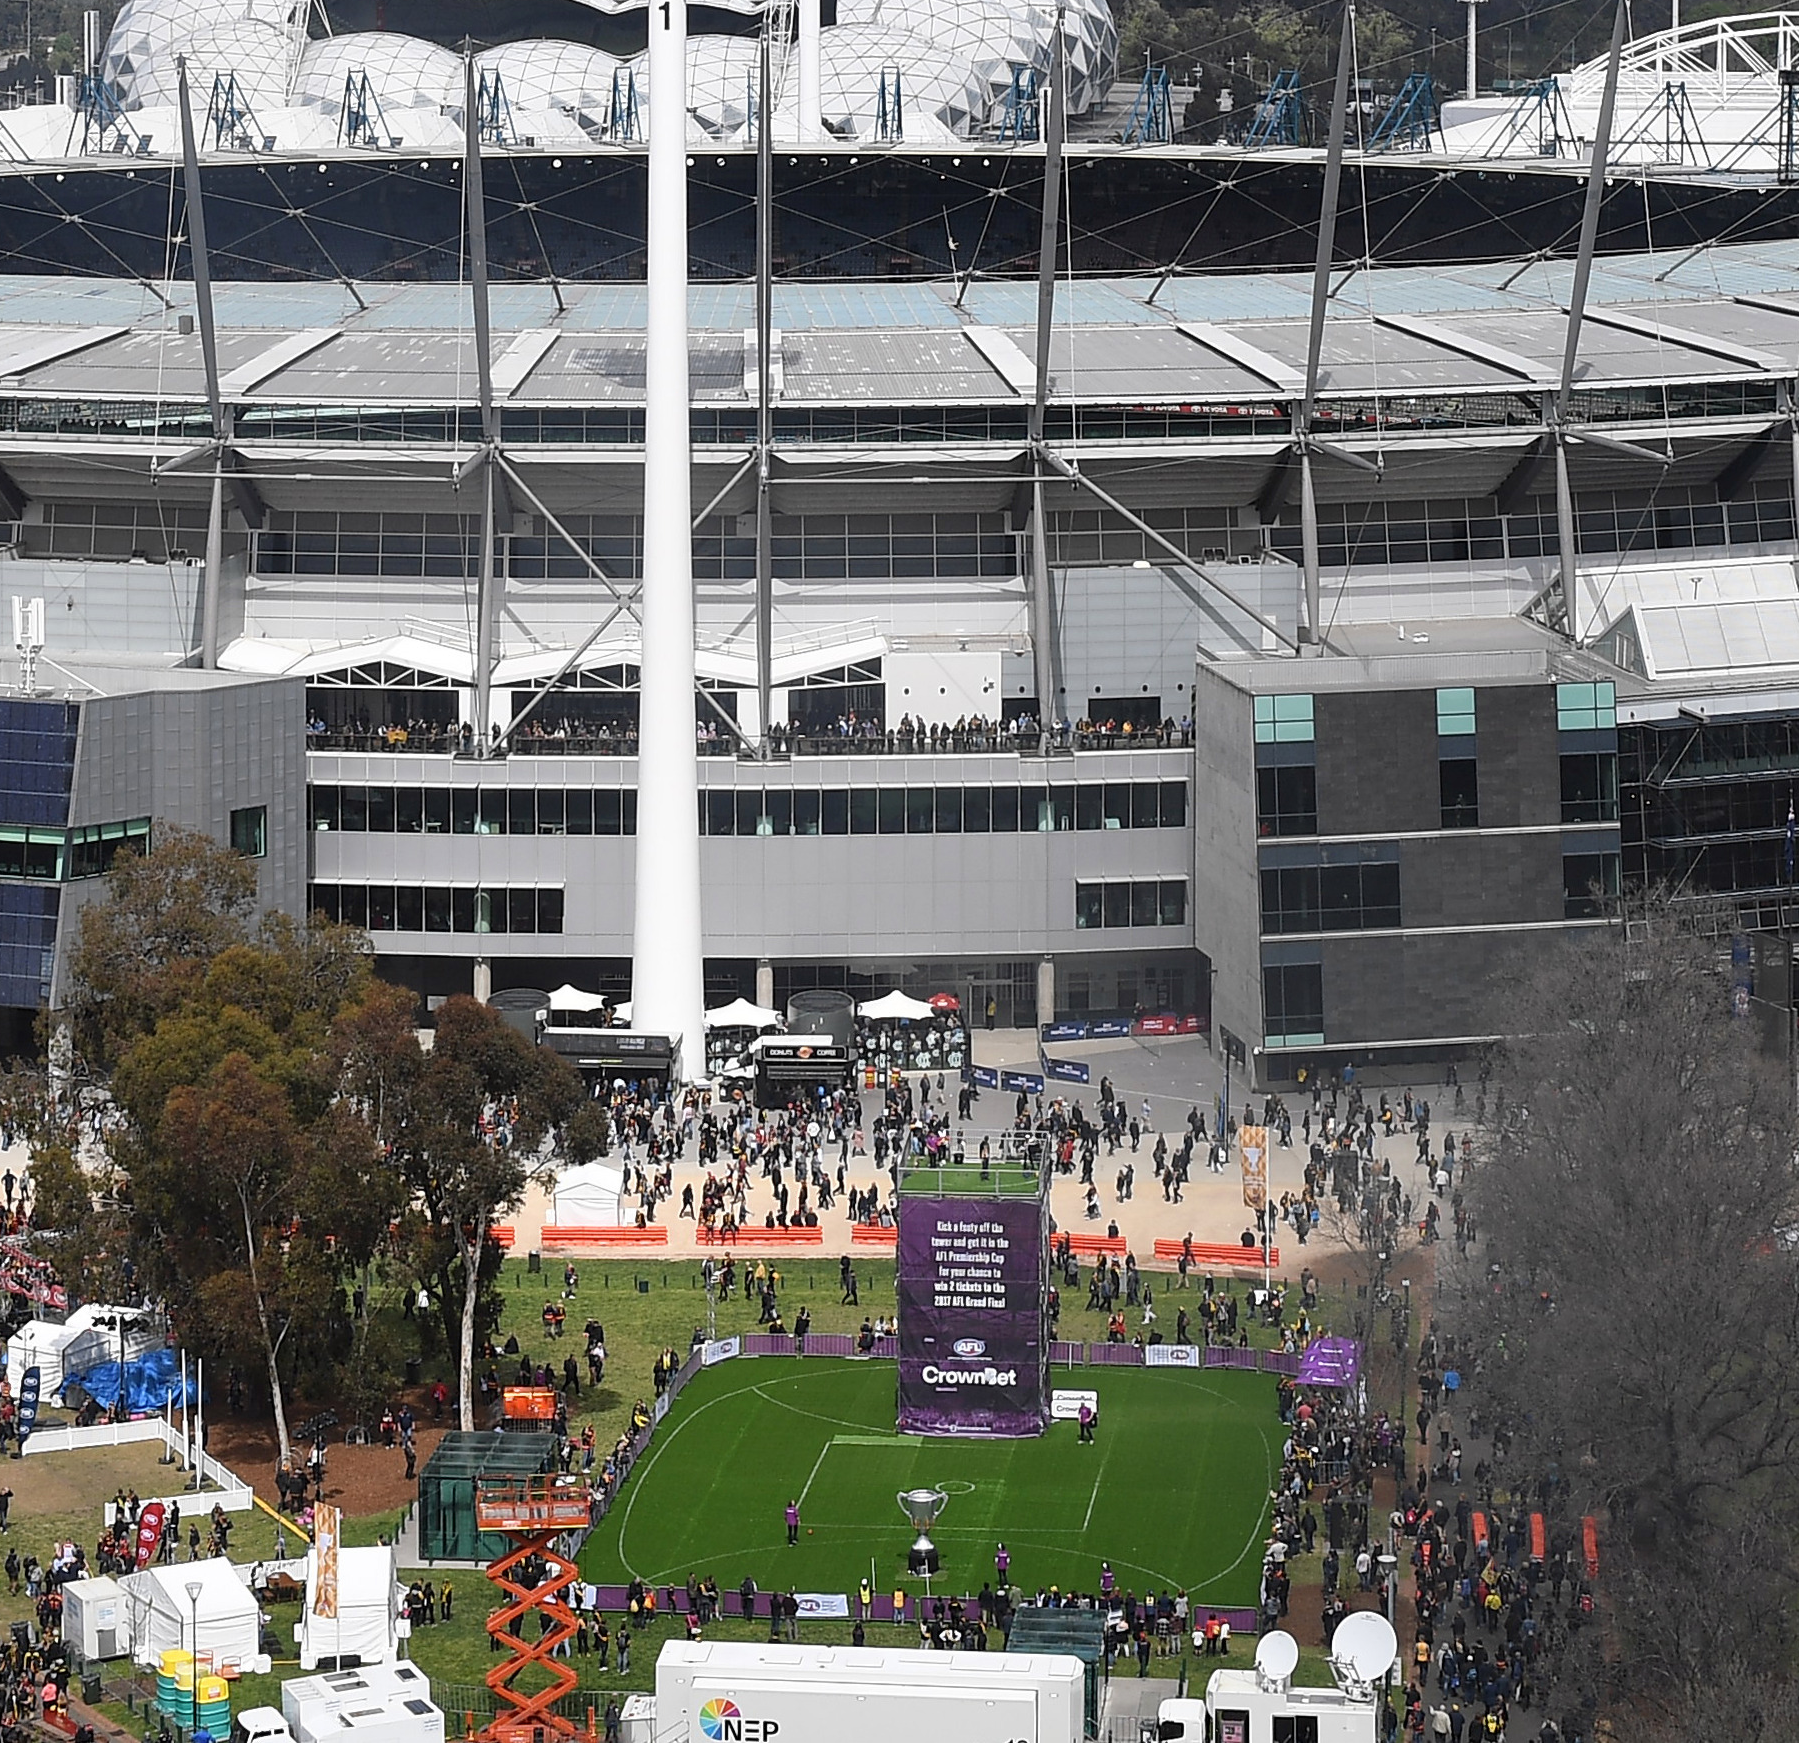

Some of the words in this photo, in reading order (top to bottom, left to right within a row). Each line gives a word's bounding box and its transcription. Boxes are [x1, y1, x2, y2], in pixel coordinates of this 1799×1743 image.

[659, 1, 670, 30] 1
[937, 1221, 952, 1232] Kick
[960, 1221, 978, 1234] footy
[992, 1223, 1004, 1233] the
[931, 1236, 952, 1247] tower
[953, 1236, 966, 1247] and
[967, 1237, 980, 1249] get
[981, 1237, 987, 1247] it
[997, 1237, 1009, 1248] the
[948, 1251, 991, 1264] Premiership
[991, 1252, 1005, 1265] Cup
[939, 1265, 949, 1276] for
[950, 1268, 966, 1279] your
[967, 1266, 992, 1278] chance
[993, 1268, 1001, 1278] to
[934, 1281, 948, 1291] win
[949, 1281, 955, 1292] 2
[955, 1281, 982, 1292] tickets
[983, 1282, 992, 1293] to
[993, 1282, 1006, 1293] the
[934, 1295, 952, 1307] 2017
[952, 1295, 964, 1307] AFL
[965, 1296, 987, 1308] Grand
[987, 1296, 1006, 1308] Final
[956, 1341, 982, 1353] AFL
[922, 1365, 1017, 1386] CrownBet
[724, 1719, 779, 1743] NEP
